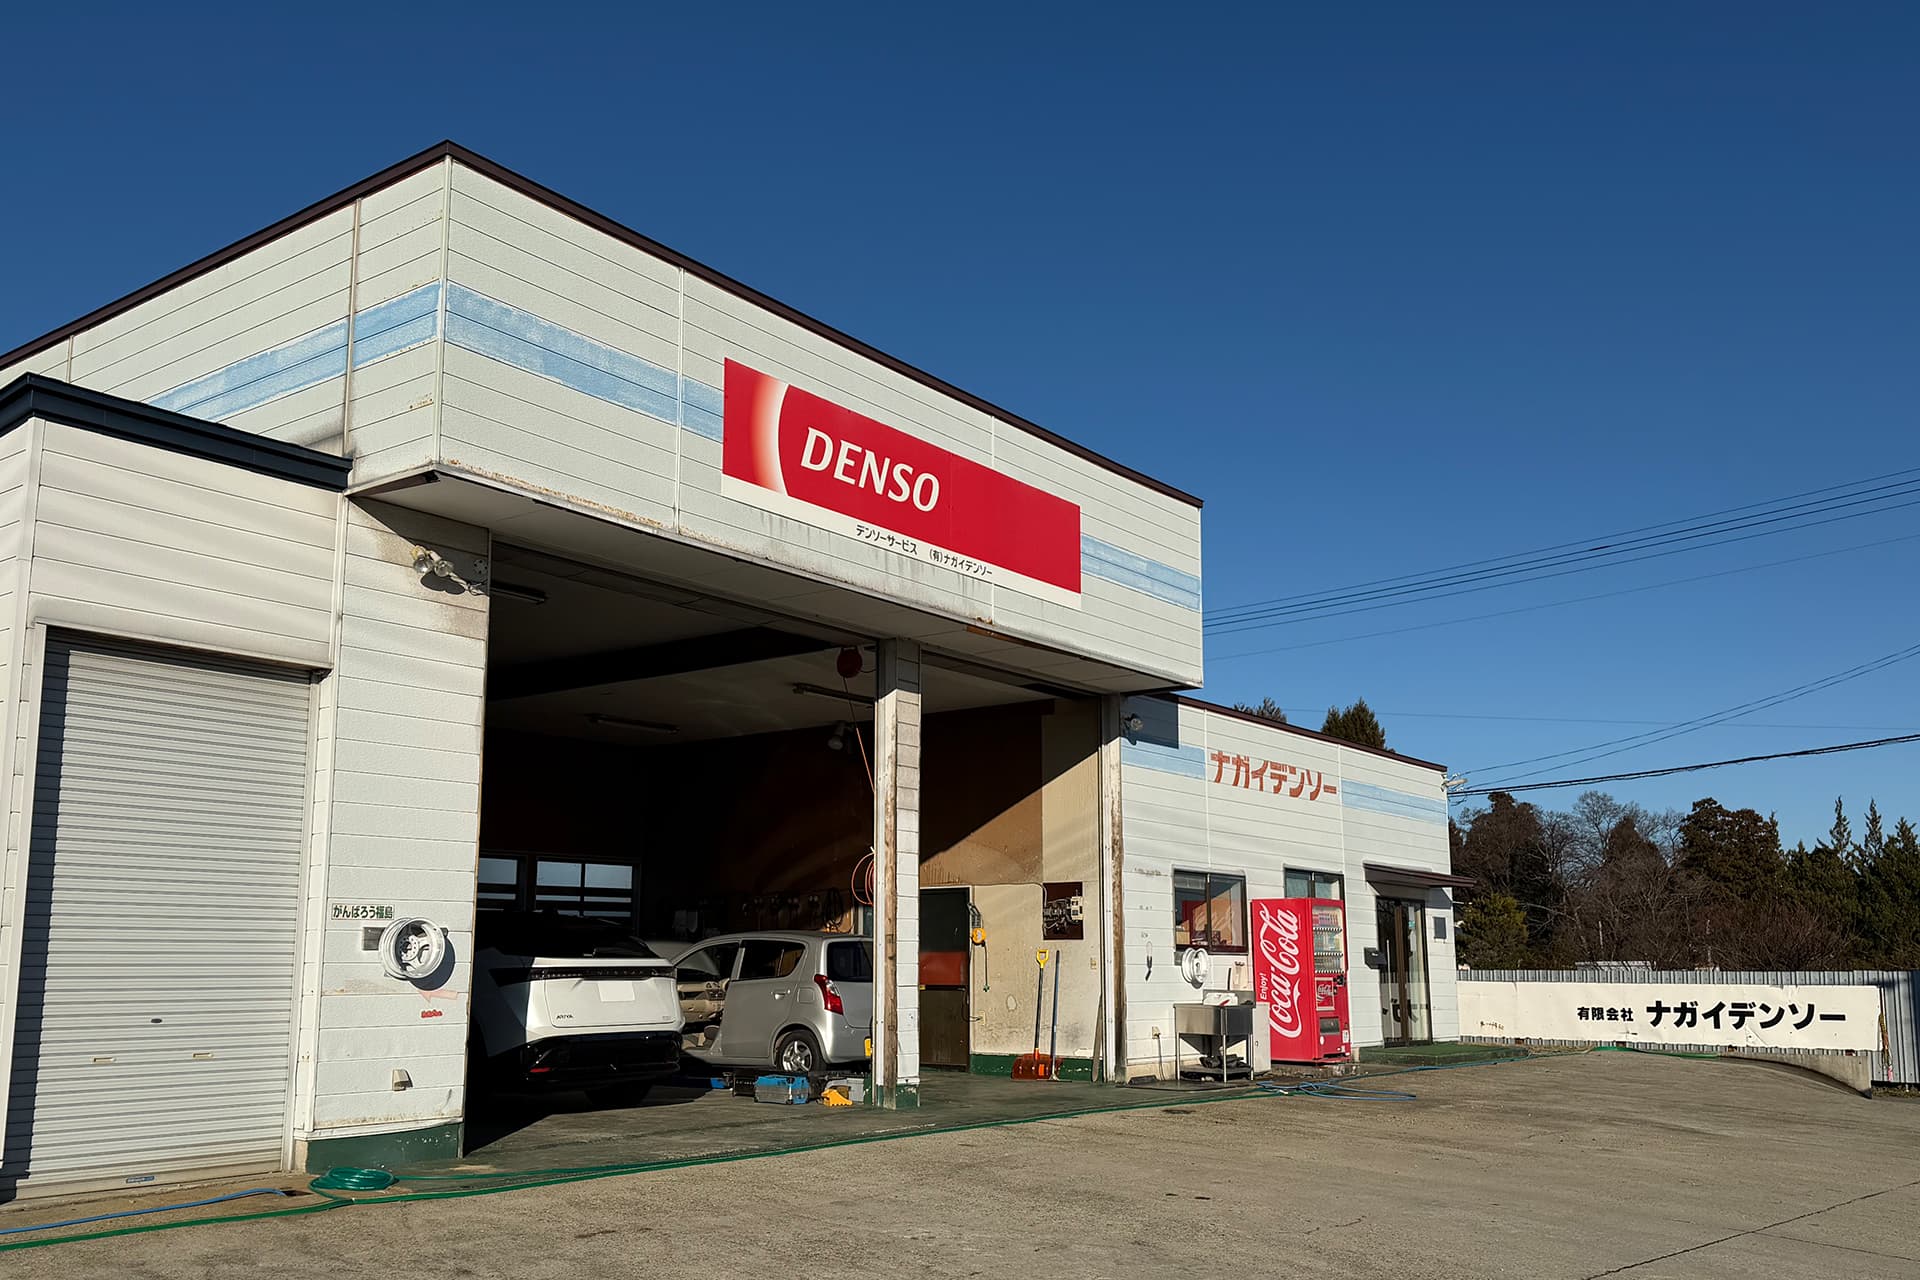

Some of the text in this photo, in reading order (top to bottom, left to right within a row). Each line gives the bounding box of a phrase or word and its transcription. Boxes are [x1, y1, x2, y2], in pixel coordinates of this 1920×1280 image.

[800, 427, 940, 512] DENSO
[856, 524, 918, 555] デンソーサービス
[1210, 750, 1337, 801] ナガイデンソー
[333, 904, 393, 919] がんばろう福島
[1259, 902, 1302, 1038] Enjoy! Coca-Cola
[1576, 1000, 1847, 1030] 有限会社 ナガイデンソー
